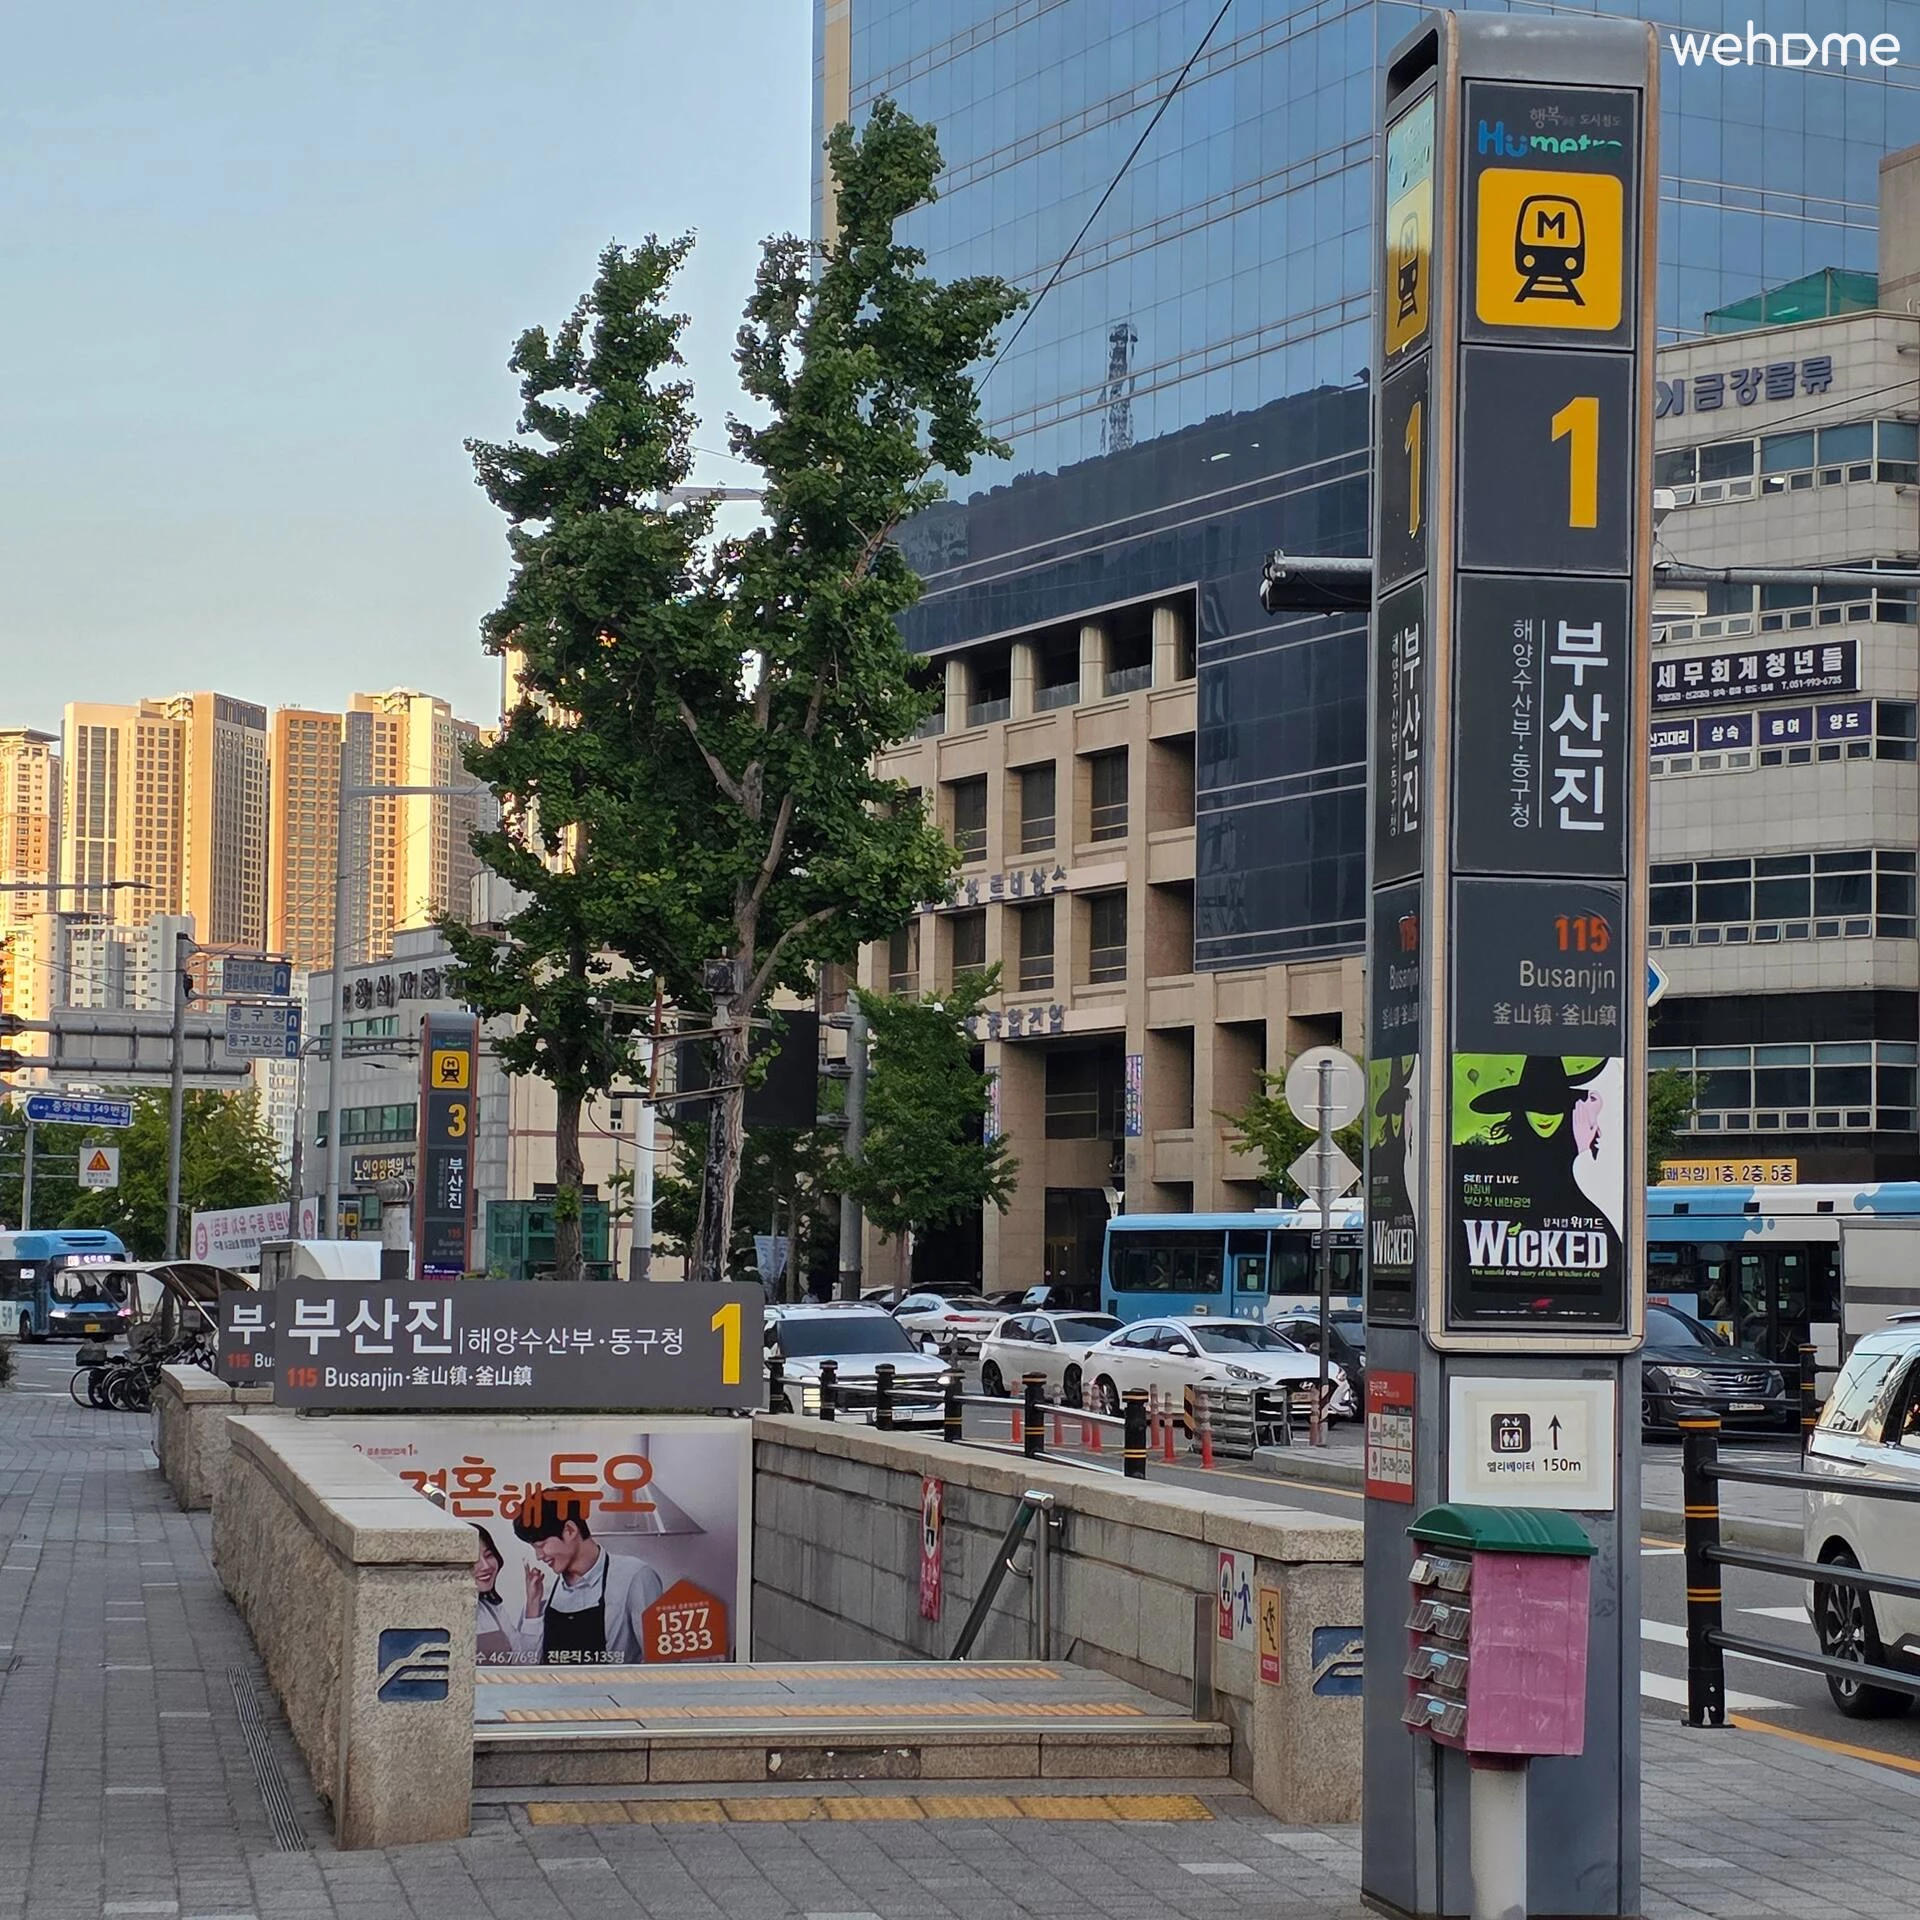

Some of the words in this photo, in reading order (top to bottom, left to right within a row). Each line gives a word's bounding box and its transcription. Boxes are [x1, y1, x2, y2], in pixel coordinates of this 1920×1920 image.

[1694, 355, 1833, 412] 금강물류
[1404, 400, 1421, 539] 1
[1551, 397, 1599, 529] 1
[1402, 622, 1420, 833] 부산진
[1549, 620, 1609, 831] 부산진
[1555, 917, 1609, 953] 115
[1520, 960, 1616, 994] Busanjin
[447, 1103, 467, 1138] 3
[447, 1158, 463, 1209] 부산진
[1484, 1174, 1494, 1184] IT
[1496, 1174, 1520, 1184] LIVE
[1771, 1165, 1793, 1182] 5층
[228, 1304, 275, 1345] 부
[288, 1299, 452, 1355] 부산진
[711, 1303, 741, 1385] 1
[227, 1353, 250, 1369] 115
[288, 1367, 318, 1388] 115
[1543, 1458, 1581, 1472] 150m
[657, 1608, 709, 1633] 1577
[657, 1629, 713, 1656] 8333
